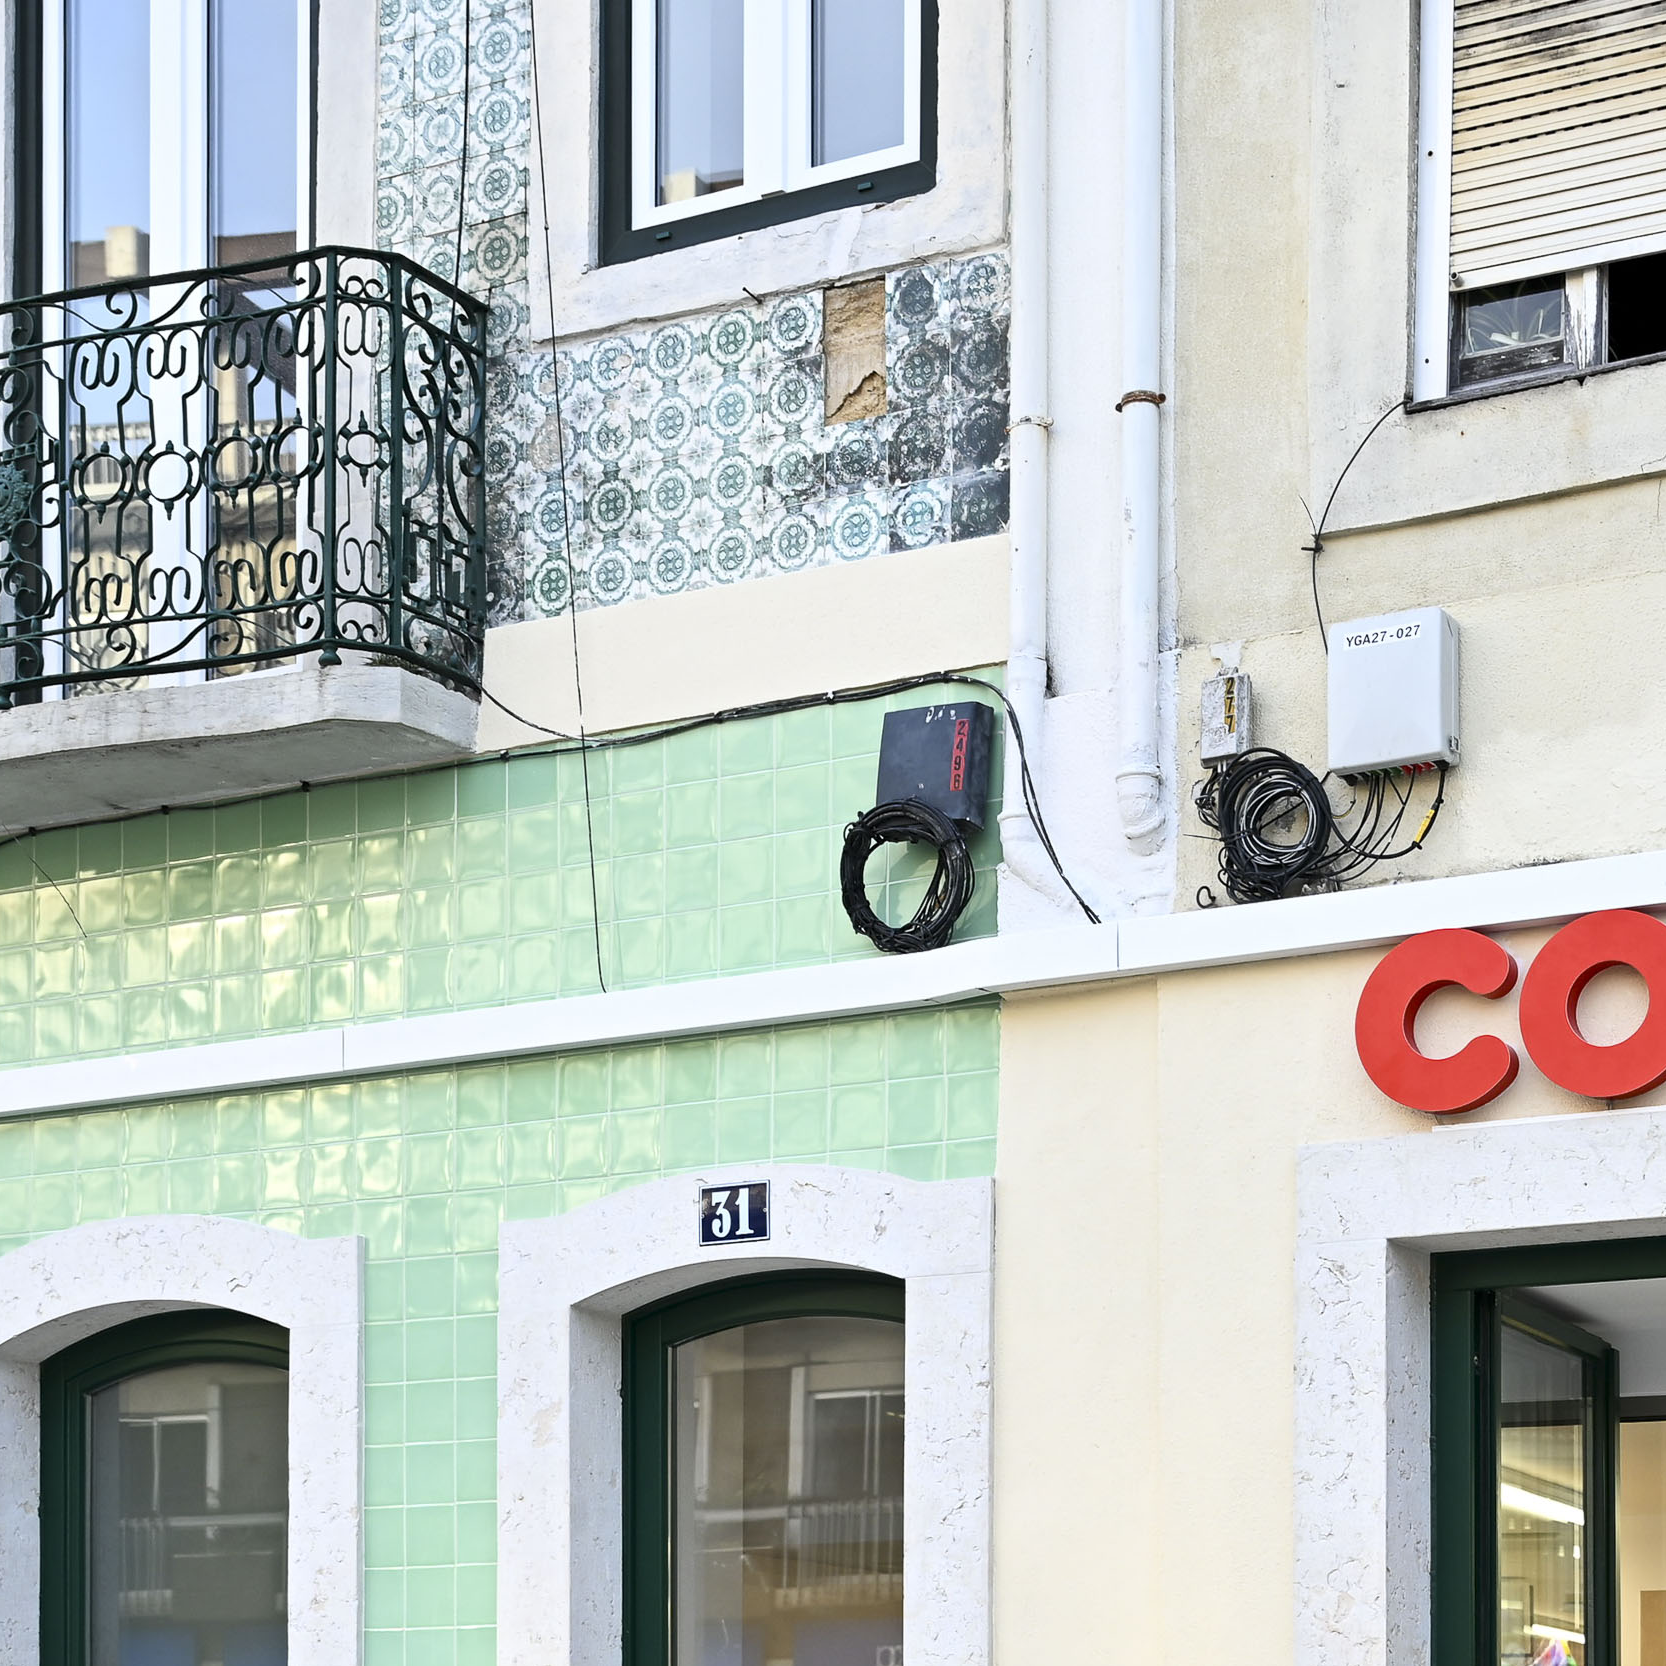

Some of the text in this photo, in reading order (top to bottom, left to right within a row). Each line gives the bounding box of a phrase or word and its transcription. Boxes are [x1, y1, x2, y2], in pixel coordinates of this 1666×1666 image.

[1345, 624, 1421, 647] YGA27-027
[953, 719, 968, 790] 2496
[711, 1187, 755, 1238] 31
